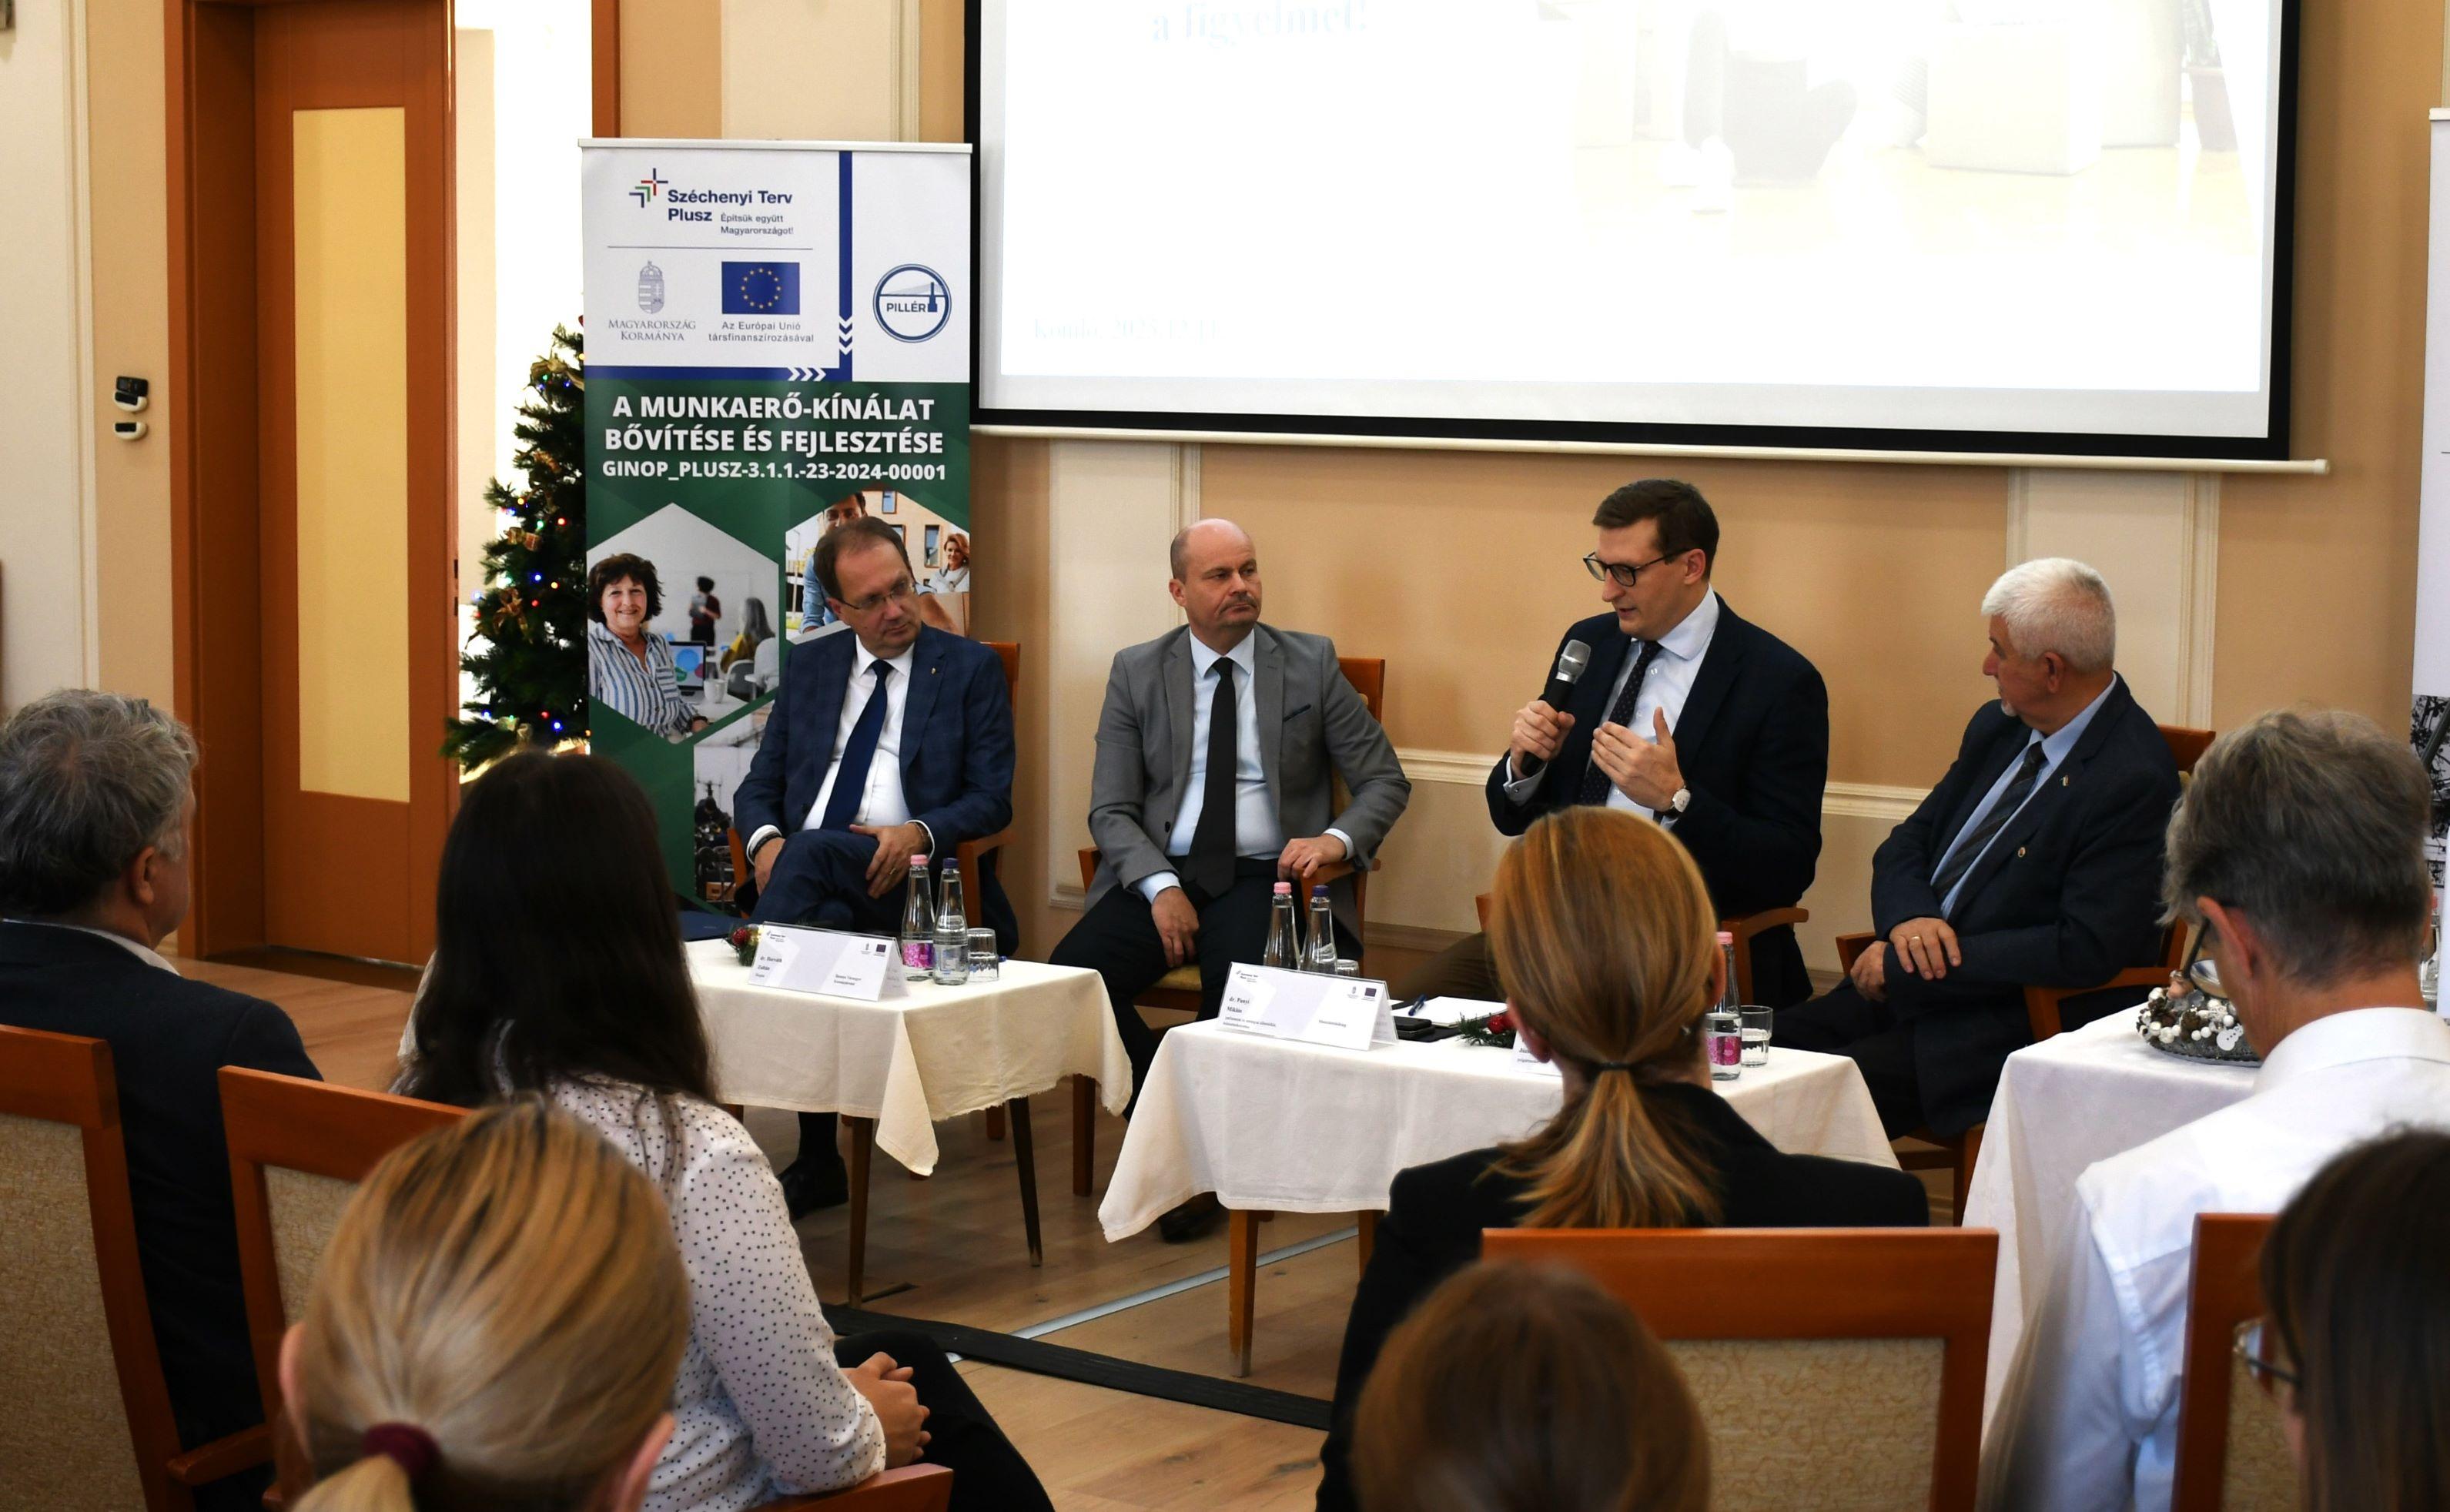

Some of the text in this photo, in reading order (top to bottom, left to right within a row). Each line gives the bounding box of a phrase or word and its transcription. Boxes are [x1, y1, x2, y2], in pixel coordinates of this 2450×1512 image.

[667, 189, 793, 206] Széchenyi Terv
[668, 208, 713, 222] Plusz
[720, 212, 784, 225] Építsük együtt
[720, 226, 795, 237] Magyarországot!
[885, 300, 926, 313] PILLÉR
[607, 318, 696, 331] MAGYARORSZÁG
[721, 320, 802, 331] Az Európai Unió
[620, 329, 685, 342] KORMÁNYA
[708, 332, 815, 343] társfinanszírozásával
[612, 391, 935, 421] A MUNKAERŐ-KÍNÁLAT
[605, 423, 943, 458] BŐVÍTÉSE ÉS FEJLESZTÉSE
[602, 460, 946, 481] GINOP_PLUSZ-3.1.1.-23-2024-00001
